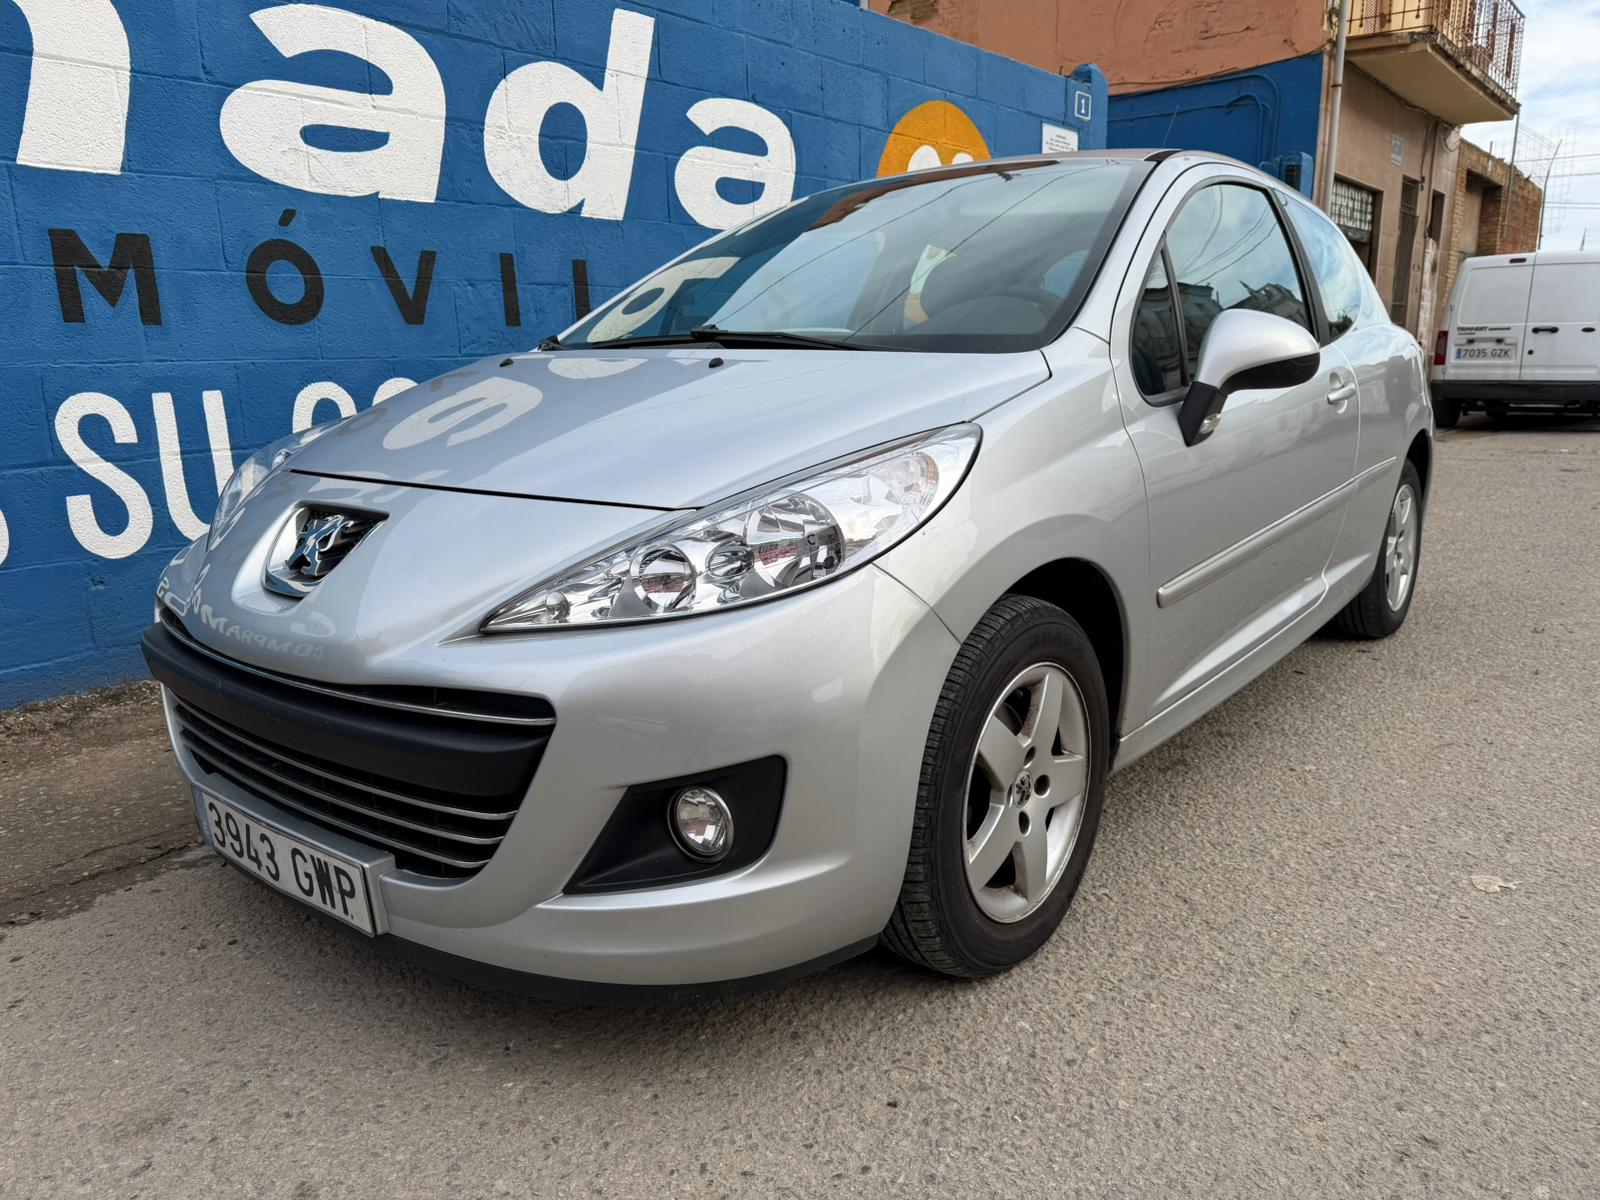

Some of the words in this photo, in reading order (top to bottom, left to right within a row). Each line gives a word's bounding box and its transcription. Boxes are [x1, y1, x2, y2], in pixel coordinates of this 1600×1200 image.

[1080, 99, 1086, 114] 1
[1462, 348, 1487, 358] 7035
[1491, 348, 1511, 358] GZK
[54, 390, 235, 560] SU
[208, 802, 280, 882] 3943
[290, 848, 356, 916] GWP
